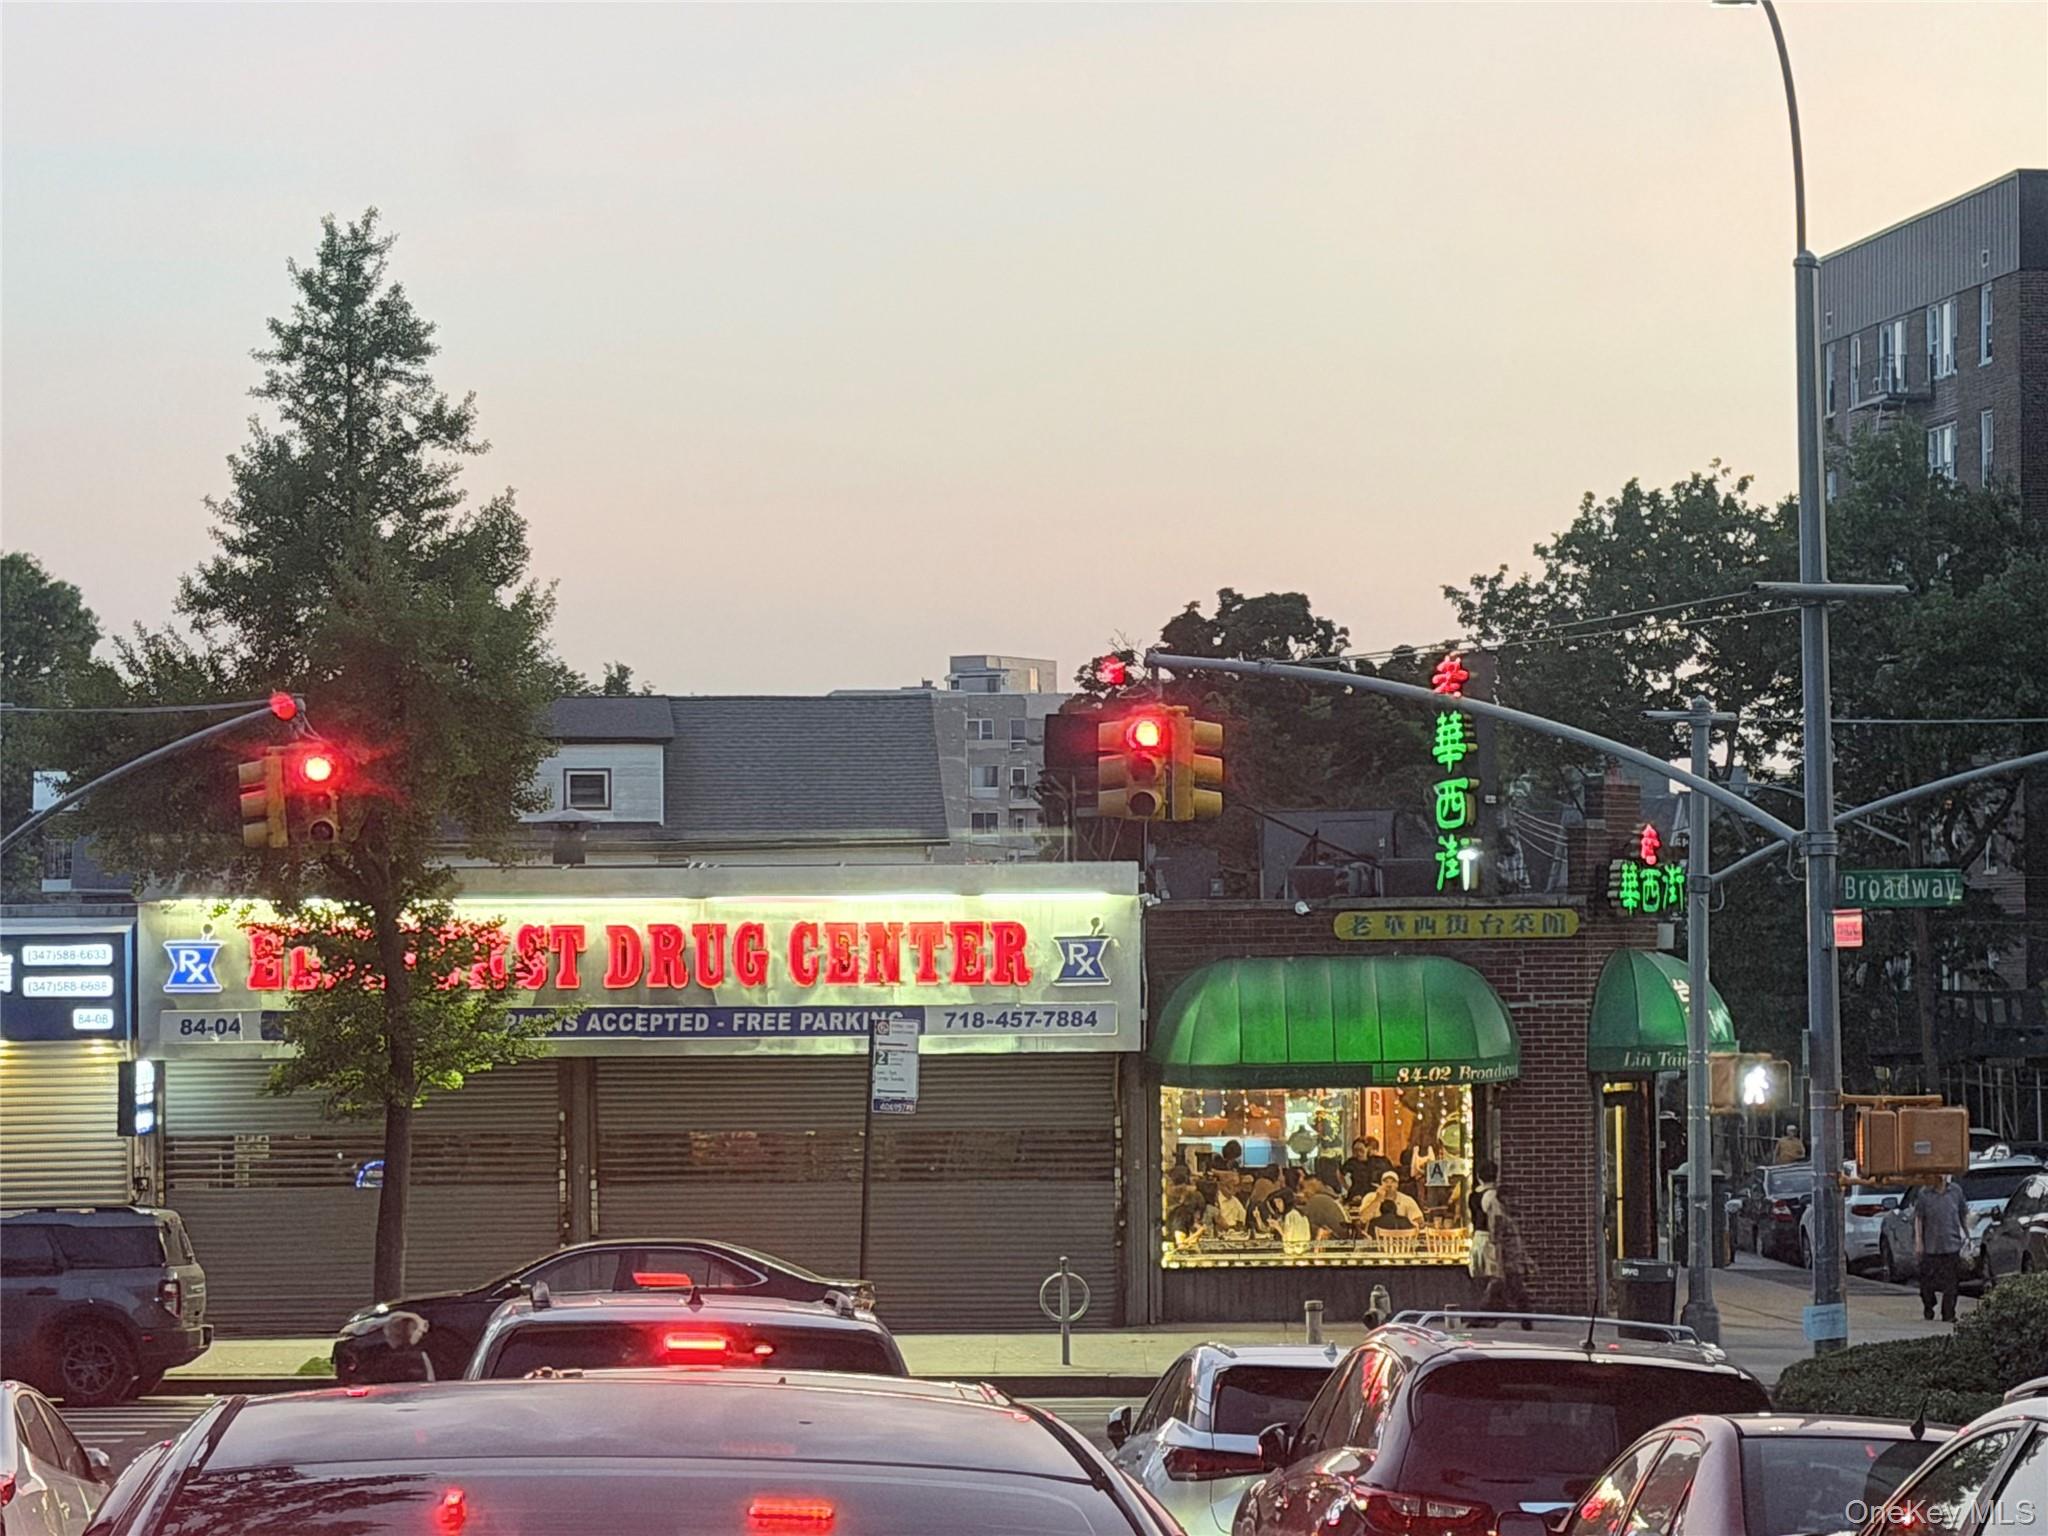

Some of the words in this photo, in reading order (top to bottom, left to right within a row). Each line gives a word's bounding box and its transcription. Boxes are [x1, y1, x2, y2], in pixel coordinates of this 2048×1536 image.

[1844, 873, 1957, 905] Broadway
[603, 920, 770, 989] DRUG
[787, 920, 1034, 988] CENTER
[180, 1018, 242, 1035] 84-04
[586, 1012, 709, 1032] ACCEPTED
[733, 1012, 792, 1031] FREE
[944, 1011, 1098, 1029] 718-457-7884
[1397, 1066, 1452, 1083] 84-02
[1430, 1163, 1444, 1179] A
